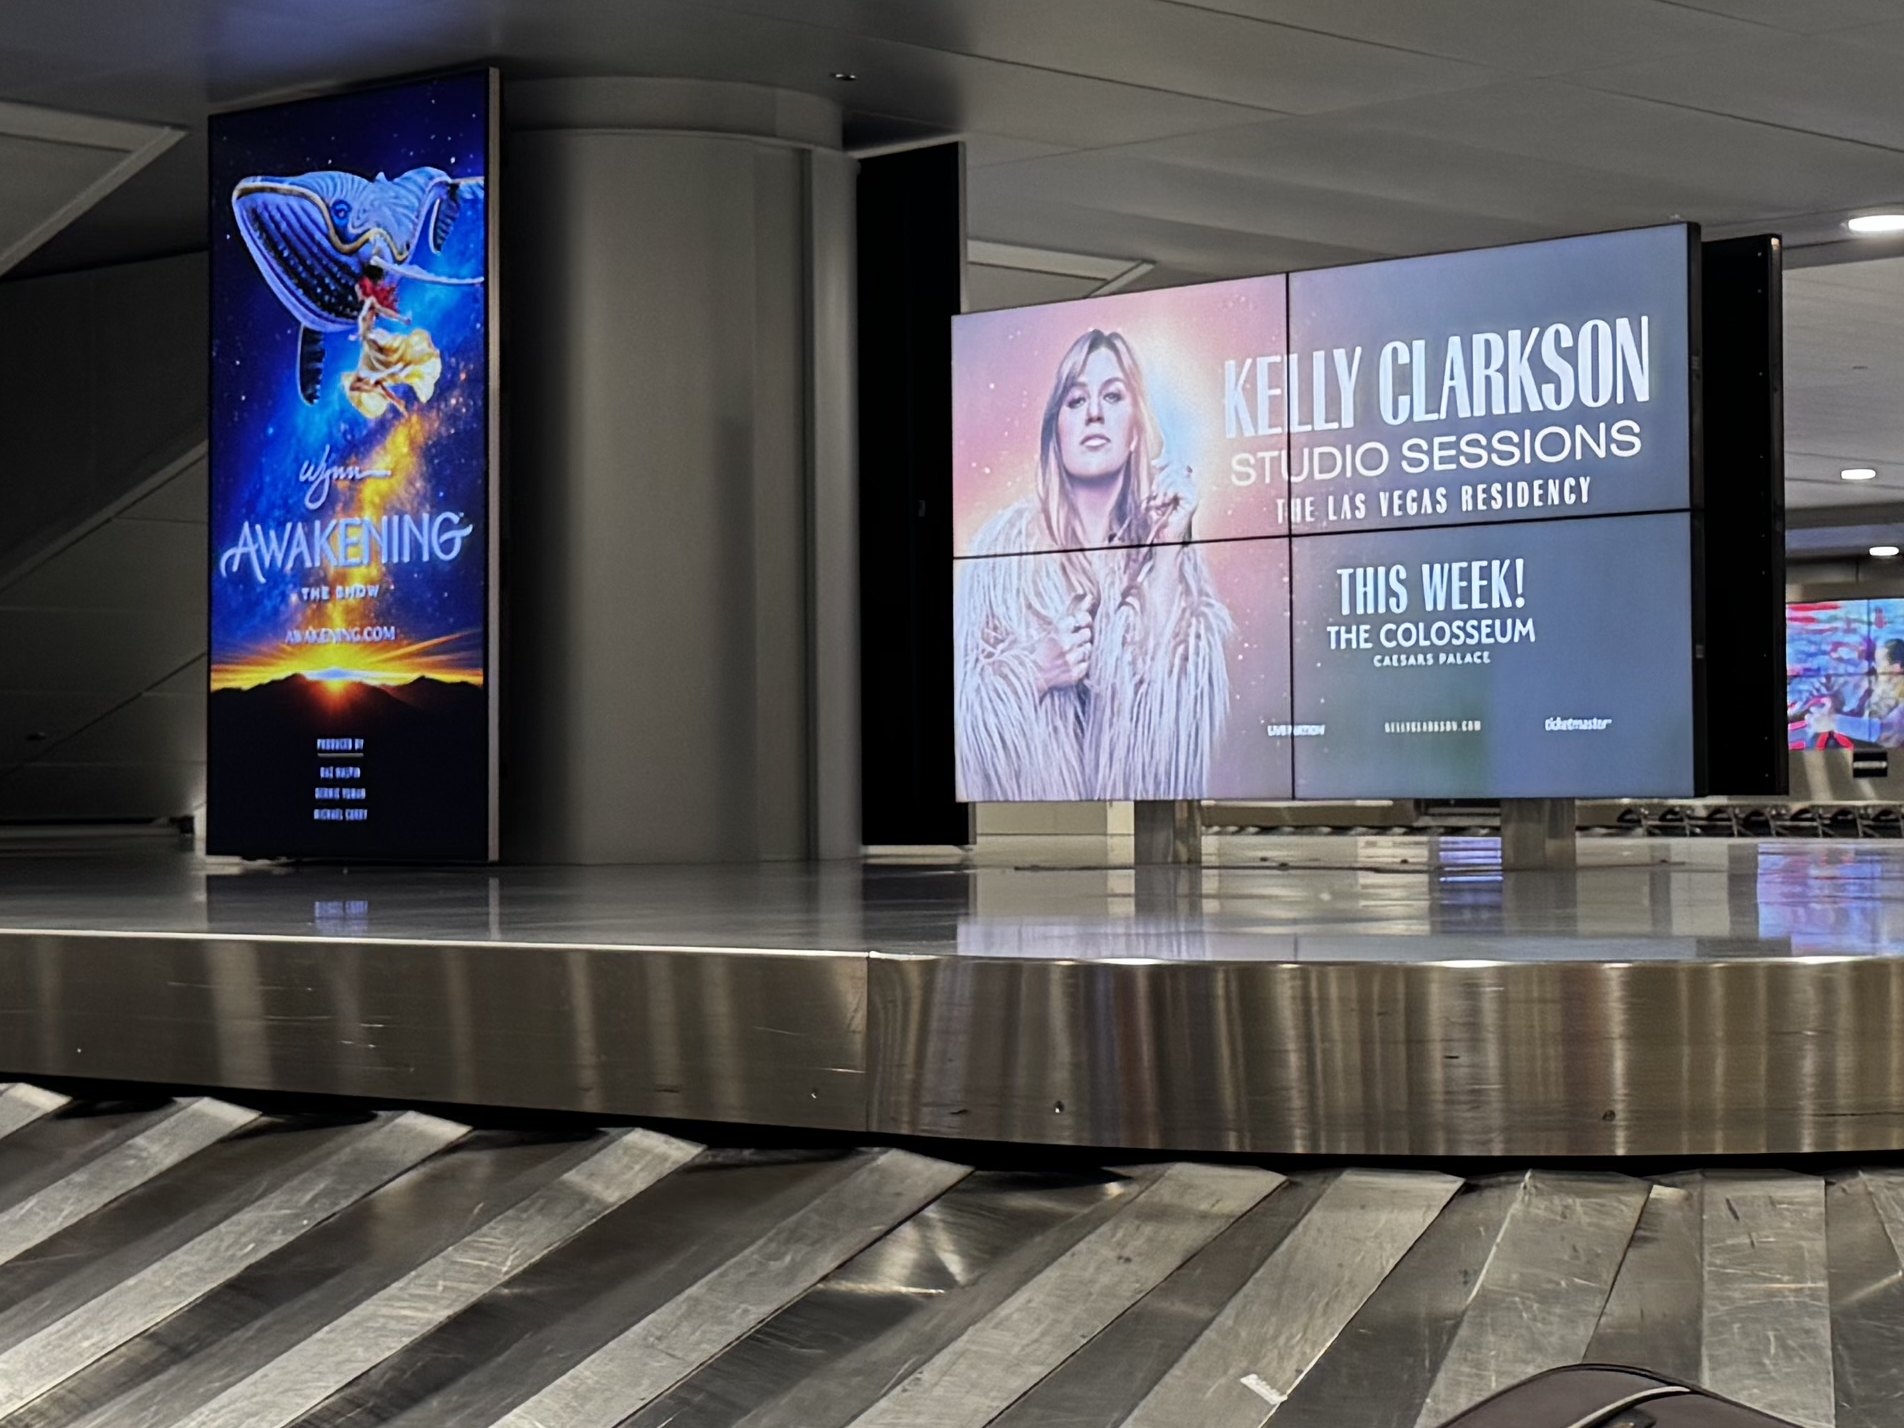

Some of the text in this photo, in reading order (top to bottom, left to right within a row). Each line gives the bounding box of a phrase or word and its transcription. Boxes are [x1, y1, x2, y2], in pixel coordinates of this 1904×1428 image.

[1224, 315, 1650, 439] KELLY CLARKSON
[1230, 419, 1642, 486] STUDIO SESSIONS
[1328, 491, 1366, 521] LAS
[1379, 486, 1447, 518] VEGAS
[1461, 476, 1591, 512] RESIDENCY
[220, 511, 474, 584] AWAKENING
[1336, 558, 1525, 616] THIS WEEK!
[1327, 618, 1536, 650] THE COLOSSEUM
[1373, 650, 1491, 668] CAESARS PALACE
